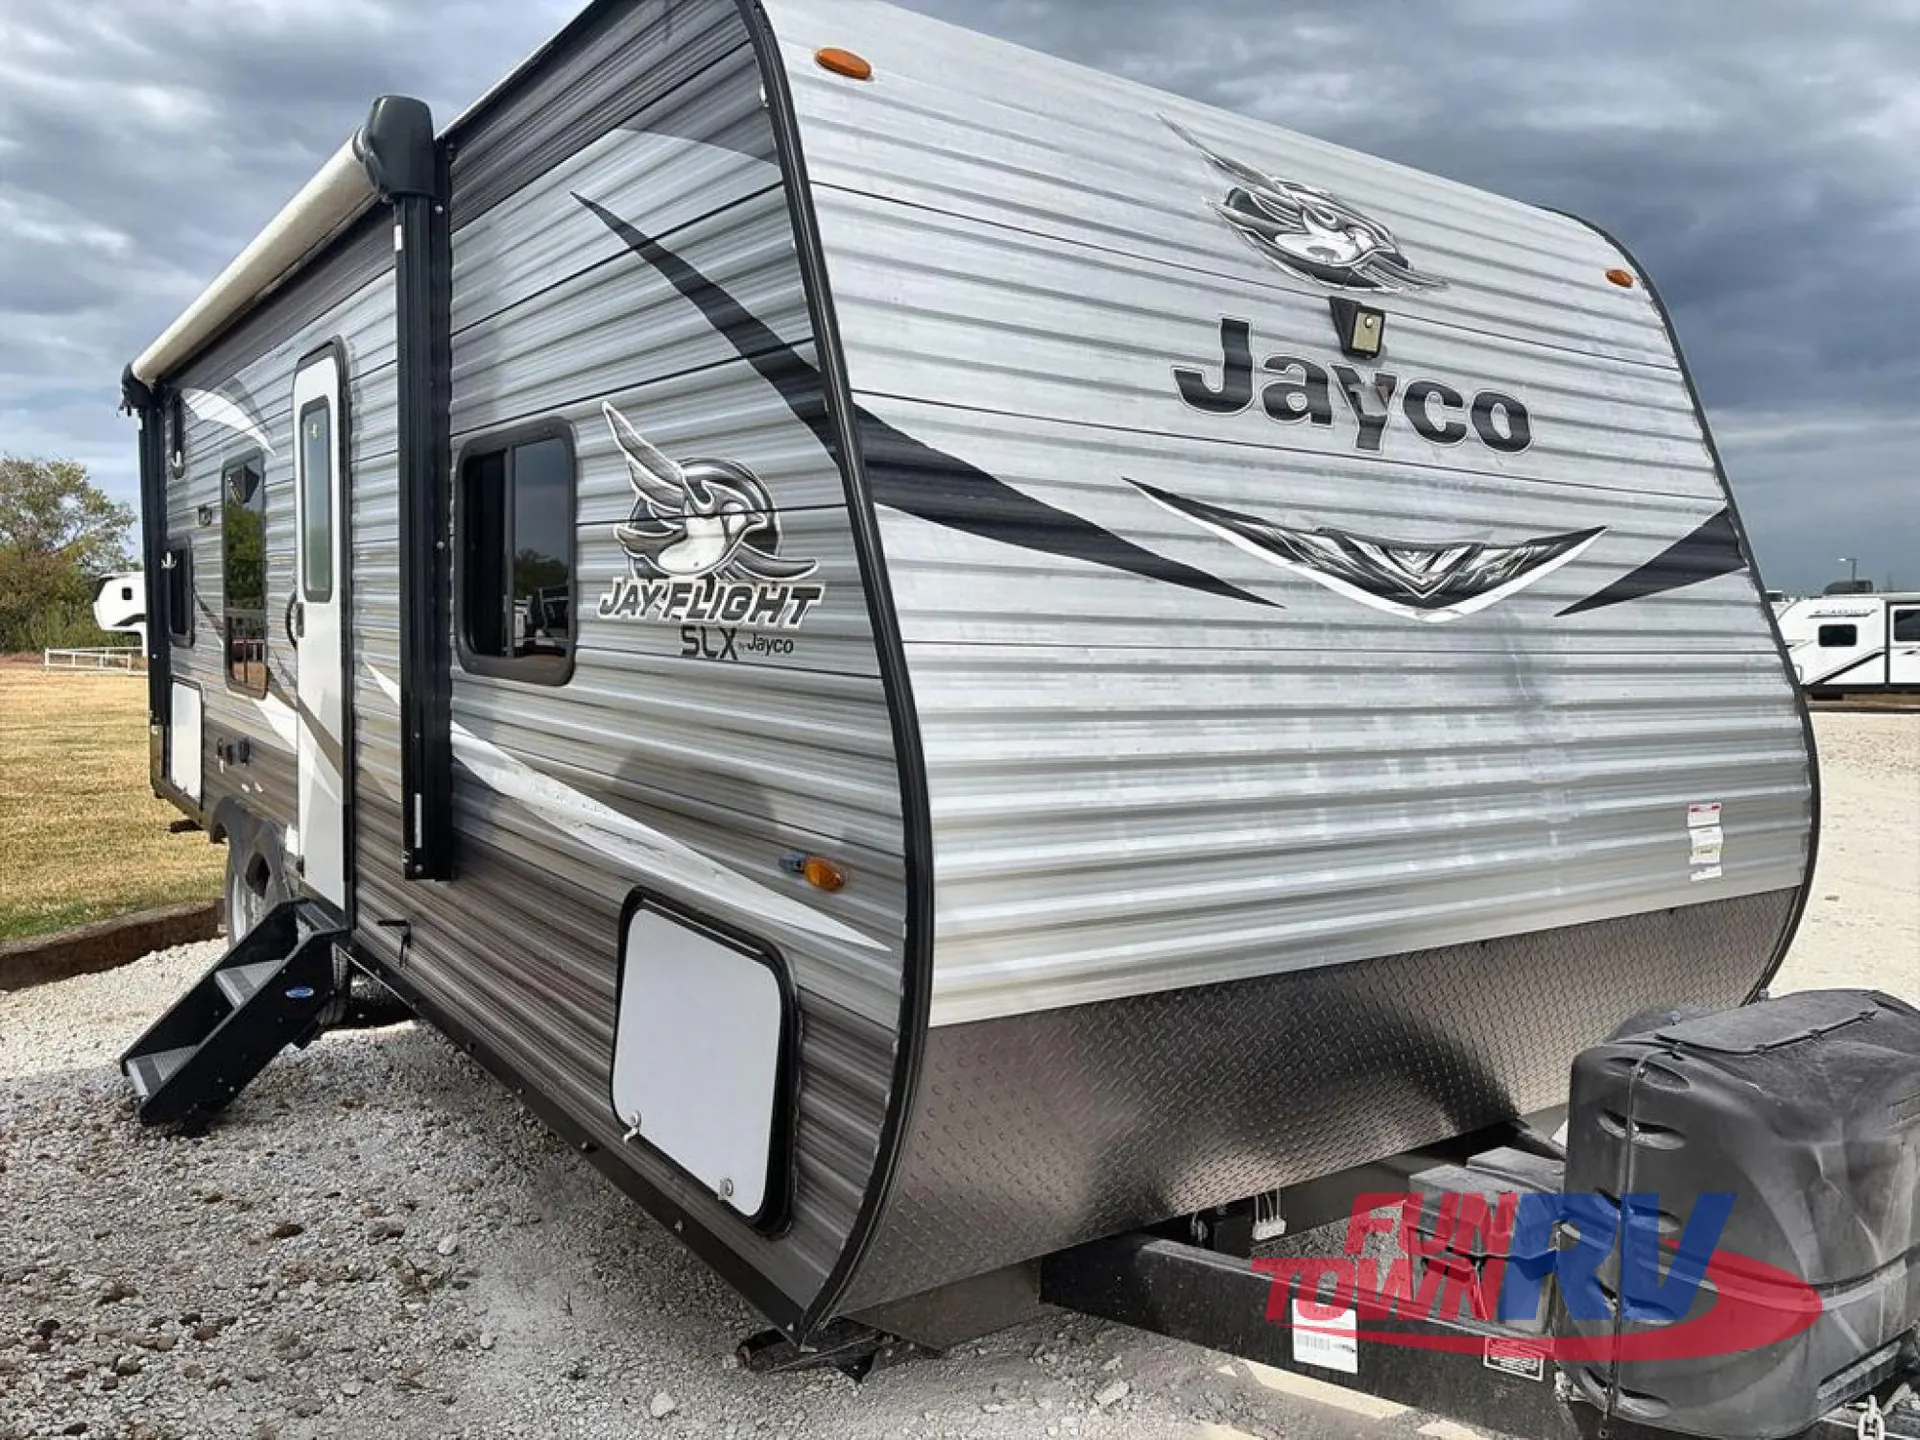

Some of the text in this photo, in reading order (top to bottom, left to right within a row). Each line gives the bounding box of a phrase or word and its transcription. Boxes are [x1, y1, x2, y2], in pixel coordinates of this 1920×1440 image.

[1172, 316, 1533, 453] Jayco
[681, 625, 795, 660] SLX Jayco
